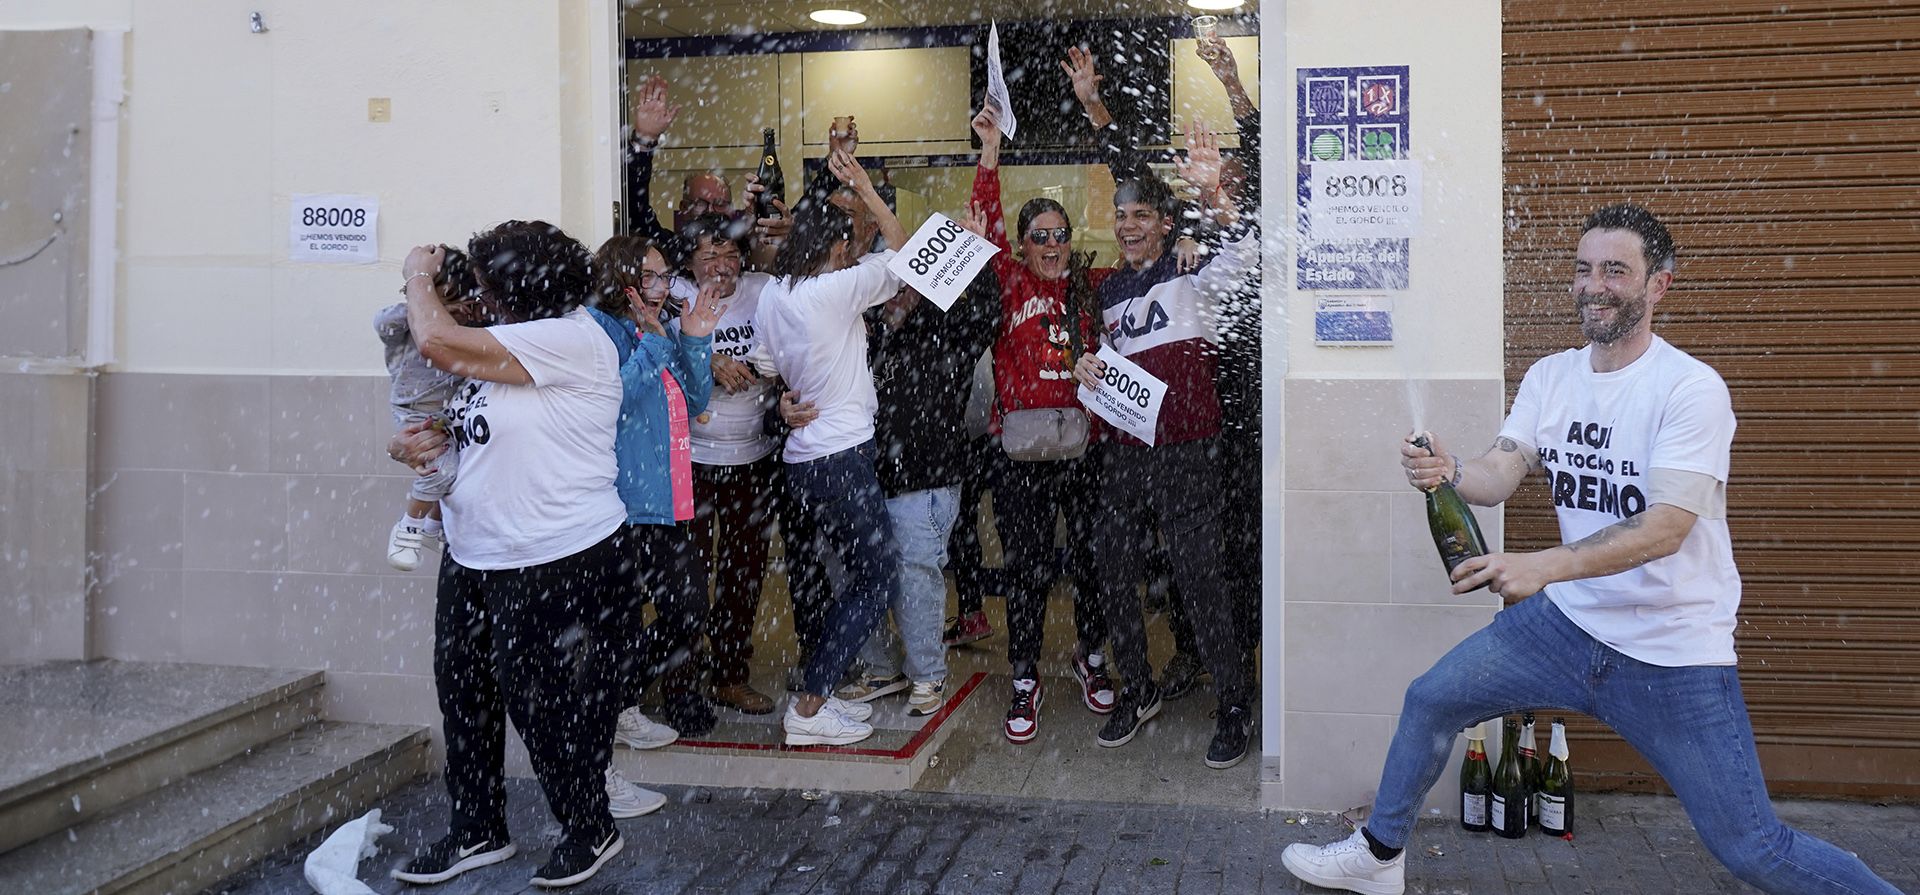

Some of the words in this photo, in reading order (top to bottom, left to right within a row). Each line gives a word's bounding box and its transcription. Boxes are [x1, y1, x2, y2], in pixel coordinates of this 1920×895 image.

[1325, 175, 1407, 197] 88008
[303, 207, 366, 227] 88008
[1335, 216, 1348, 224] EL
[1349, 216, 1384, 224] GORDO
[320, 243, 348, 251] GORDO
[335, 234, 367, 242] VENDIDO
[908, 220, 965, 276] 88008
[944, 277, 955, 286] EL
[952, 250, 975, 277] GORDO
[1305, 249, 1373, 266] Apuestas
[1377, 249, 1401, 263] del
[1305, 267, 1355, 281] Estado
[715, 320, 755, 343] AQUÍ
[1095, 395, 1104, 405] EL
[1104, 402, 1127, 421] GORDO
[1116, 400, 1147, 423] VENDIDO
[1567, 418, 1616, 449] AQUÍ
[1538, 447, 1559, 463] HA
[1621, 460, 1640, 476] EL
